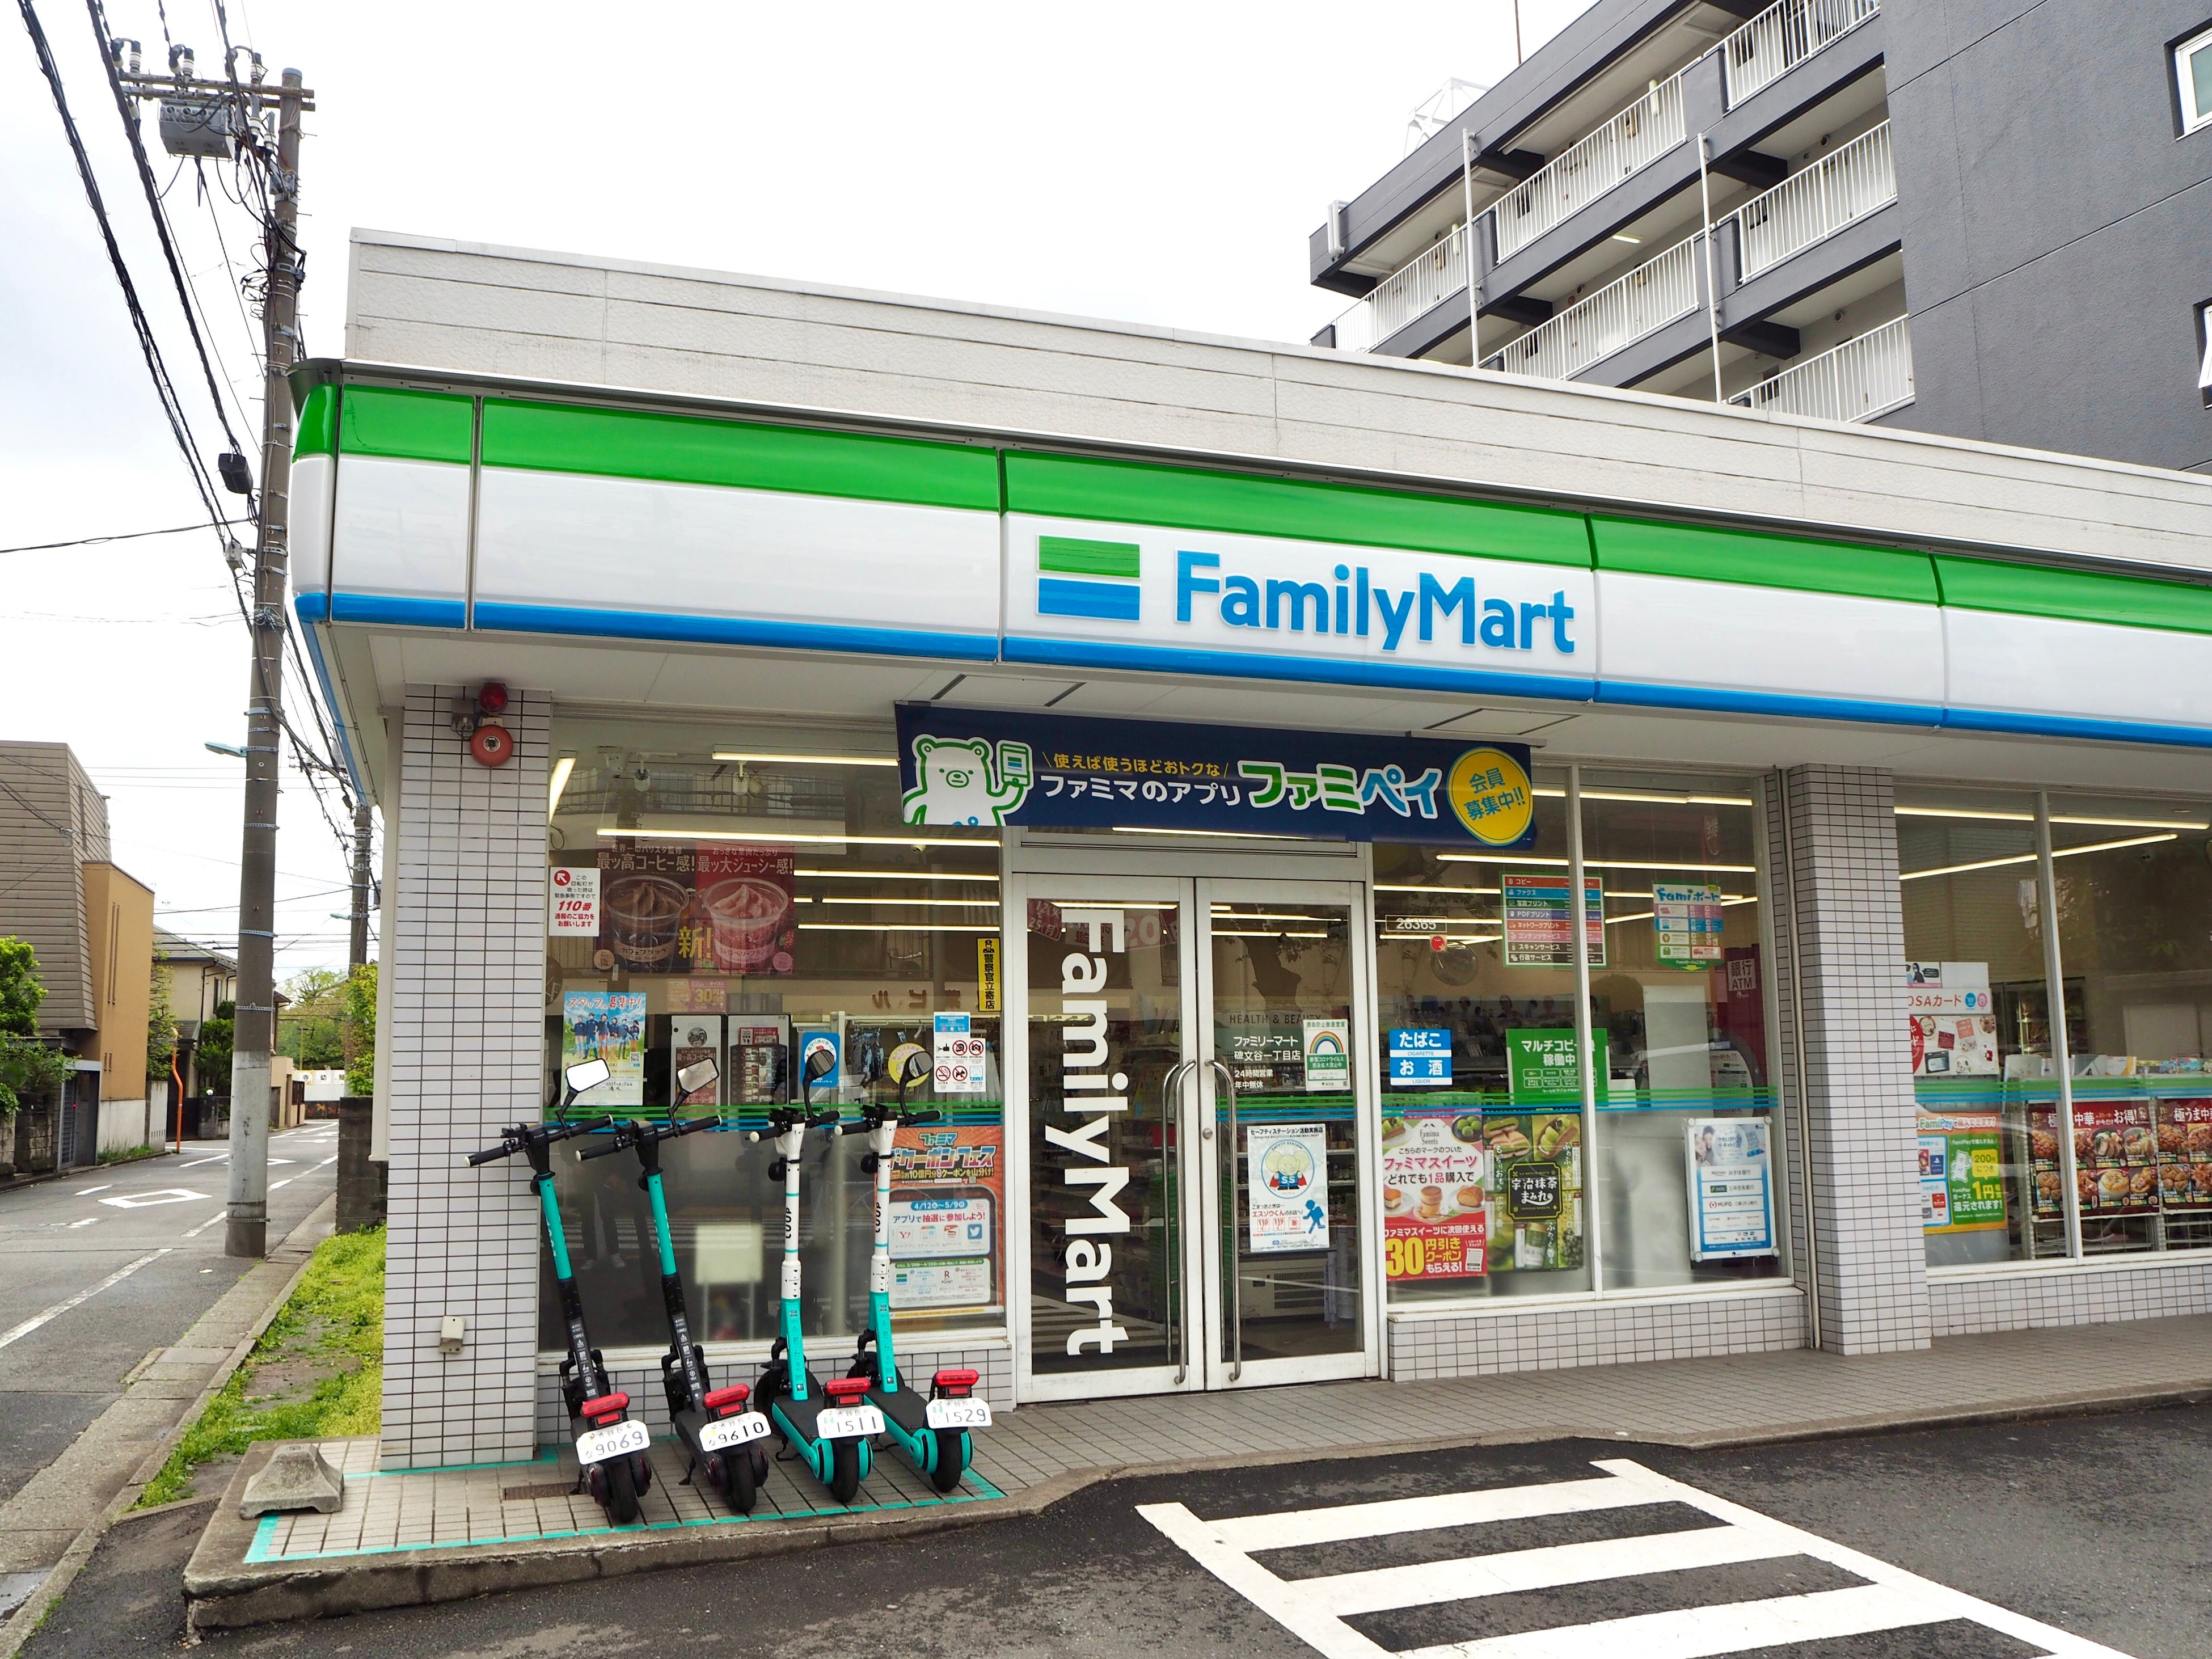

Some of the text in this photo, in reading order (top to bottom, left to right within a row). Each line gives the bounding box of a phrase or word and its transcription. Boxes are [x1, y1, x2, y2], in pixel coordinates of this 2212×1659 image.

[1176, 550, 1575, 655] FamilyMart
[1053, 754, 1220, 777] 使えば使うほどおトクな
[1469, 767, 1505, 794] 会員
[1040, 775, 1240, 806] ファミマのアプリ
[1238, 760, 1442, 819] ファミペイ
[1463, 786, 1526, 821] 募集中!!
[597, 852, 695, 872] 最ッ高コーヒー感!
[698, 856, 793, 875] 最ッ大ジューシー感!
[559, 900, 592, 911] 110番
[1396, 917, 1437, 930] 26365
[678, 926, 712, 959] 新!
[1730, 960, 1751, 977] 銀行
[983, 953, 995, 1009] 警察官立寄店
[1732, 977, 1753, 990] ATM
[1230, 1014, 1268, 1024] HEALTH
[1273, 1014, 1280, 1023] &
[1233, 1035, 1298, 1047] ファミリーマート
[1399, 1032, 1441, 1048] たばこ
[1234, 1050, 1301, 1061] 碑文谷一丁目店
[1543, 1053, 1576, 1066] 稼働中
[1234, 1069, 1273, 1078] 24時間営業
[1234, 1080, 1264, 1089] 年中無休
[919, 1132, 958, 1146] ファミマ
[1045, 909, 1130, 1356] FamilyMart
[1420, 1129, 1440, 1138] Famima
[1399, 1146, 1462, 1155] こちらのマークのついた
[1384, 1155, 1478, 1172] ファミマスイーツ
[1388, 1171, 1474, 1185] どれでも1品購入で
[1511, 1177, 1557, 1191] 宇治抹茶
[1521, 1191, 1554, 1206] まみれ
[1425, 1237, 1461, 1251] 円引き
[1386, 1237, 1425, 1277] 30
[1425, 1251, 1462, 1263] クーポン
[1425, 1261, 1462, 1274] もらえる!
[945, 1408, 986, 1423] 1529
[837, 1416, 876, 1433] 1511
[718, 1422, 764, 1443] 9610
[596, 1431, 643, 1455] 9069
